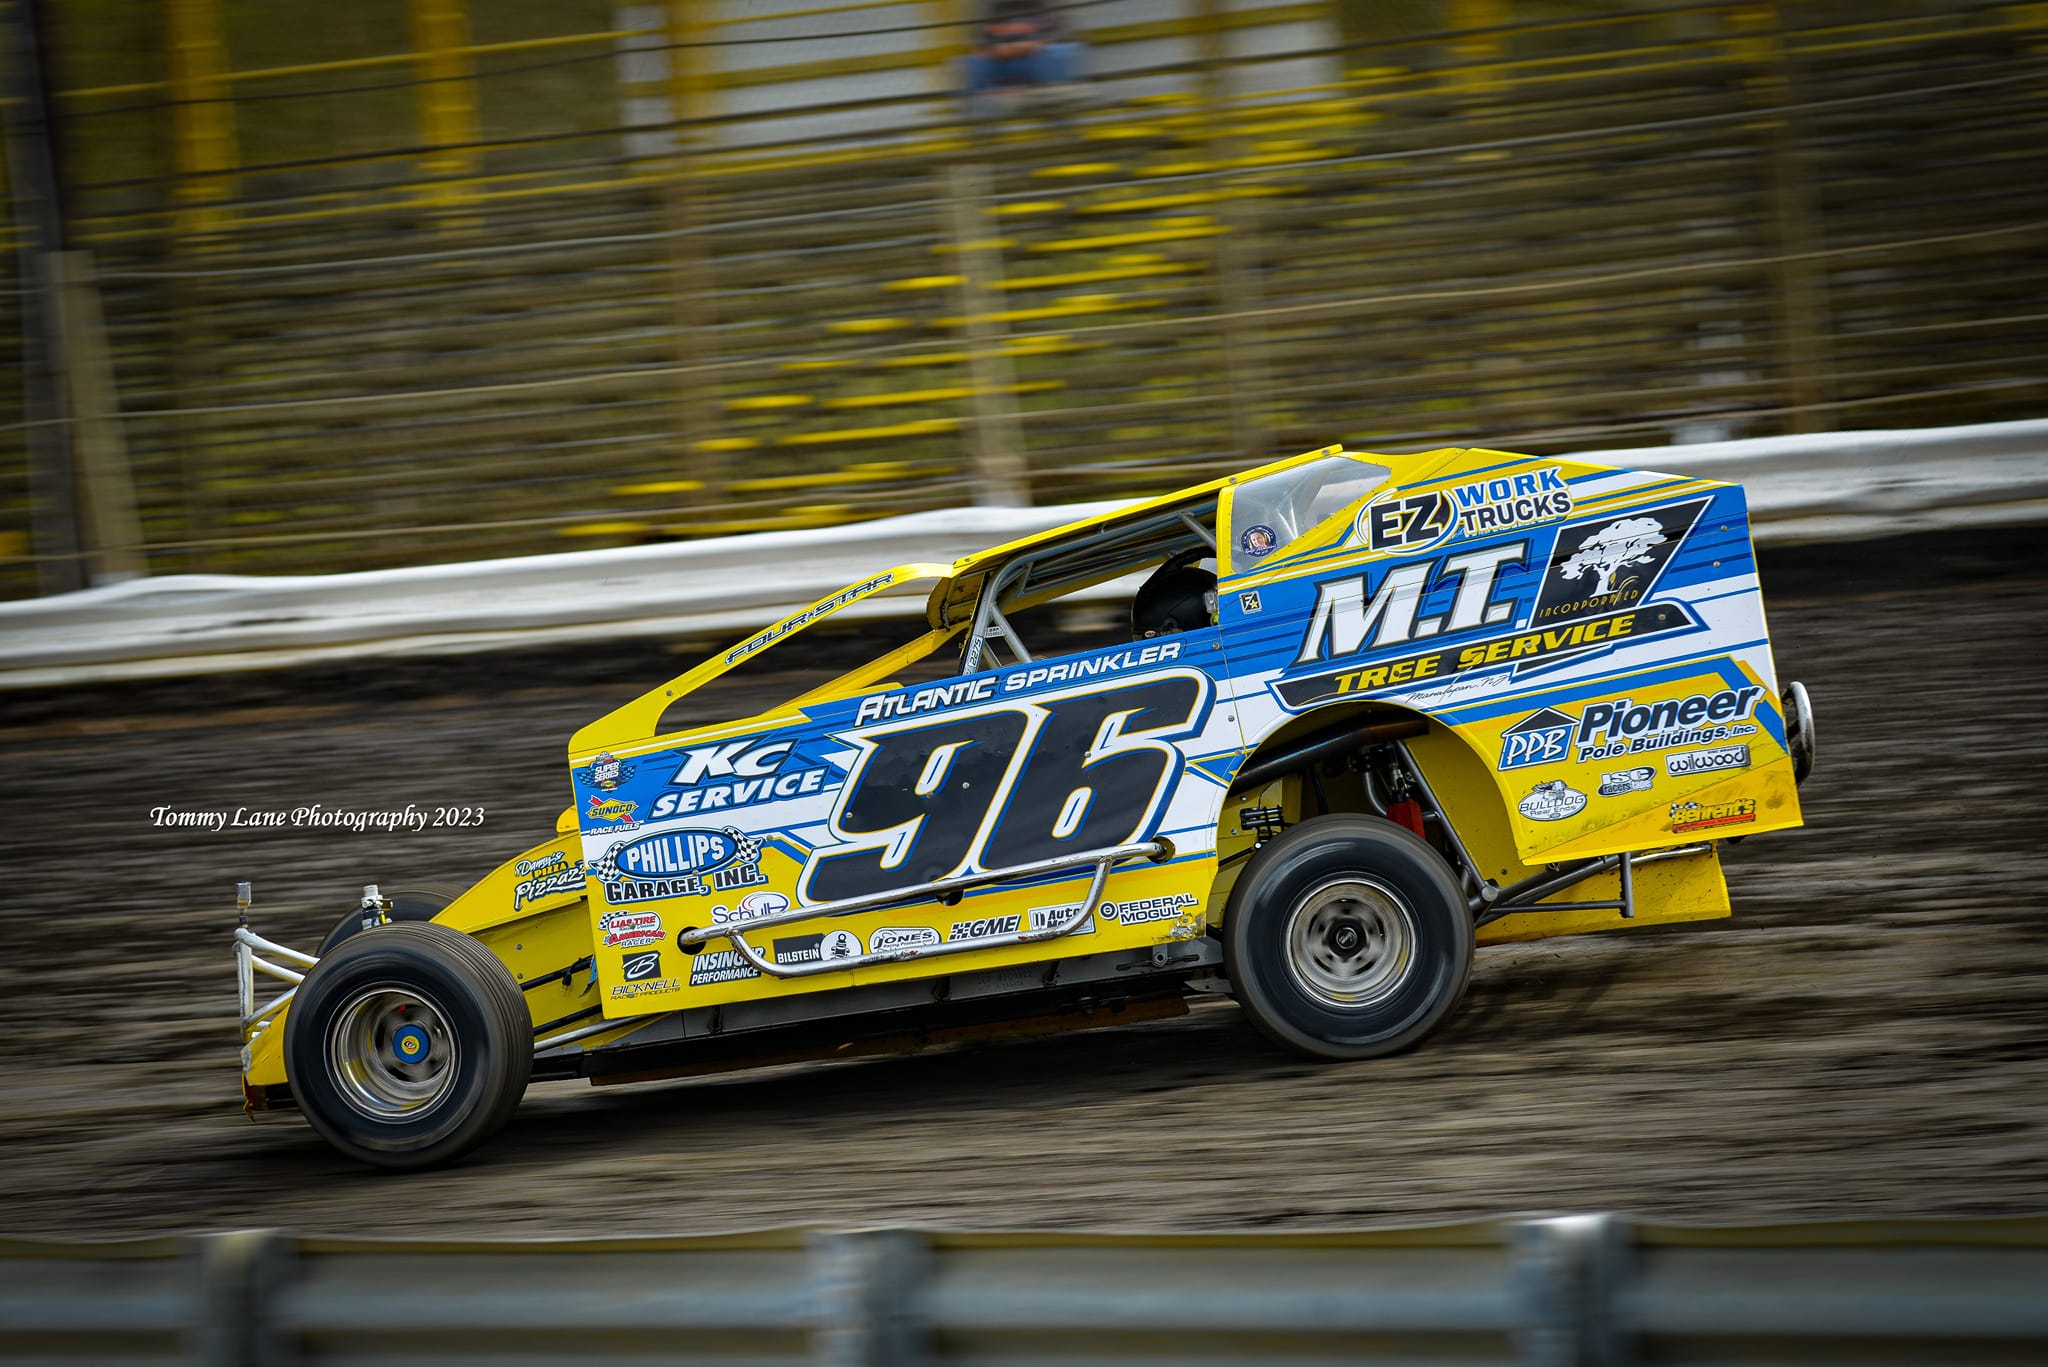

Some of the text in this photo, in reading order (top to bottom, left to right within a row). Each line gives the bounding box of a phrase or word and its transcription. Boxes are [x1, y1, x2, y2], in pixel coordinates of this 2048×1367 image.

[1455, 467, 1568, 508] WORK
[1370, 493, 1442, 551] EZ
[1460, 491, 1573, 534] TRUCKS
[1297, 542, 1526, 663] M.T.
[1335, 614, 1637, 694] TREE SERVICE
[854, 642, 1182, 727] ATLANTIC SPRINKLER
[1577, 686, 1764, 744] Pioneer
[1507, 728, 1567, 765] PPB
[1579, 745, 1628, 762] Pole
[1631, 725, 1730, 753] Buildings,
[595, 762, 620, 774] SUPER
[671, 738, 796, 785] KC
[1669, 747, 1745, 772] wilwood
[594, 771, 619, 783] SERIES
[800, 666, 1215, 906] 96
[651, 768, 825, 820] SERVICE
[1520, 795, 1586, 812] BULLDOG
[592, 803, 633, 817] SUNOCO
[590, 822, 640, 836] RACE FUELS
[626, 835, 726, 873] PHILLIPS
[605, 864, 764, 902] GARAGE, INC.
[1119, 894, 1196, 913] FEDERAL
[1120, 907, 1182, 923] MOGUL
[634, 916, 656, 924] TIRE
[621, 938, 651, 947] RACER
[874, 932, 933, 949] JONES
[777, 949, 820, 964] BILSTEIN
[611, 977, 681, 996] BICKNELL
[691, 967, 759, 985] PERFORMANCE
